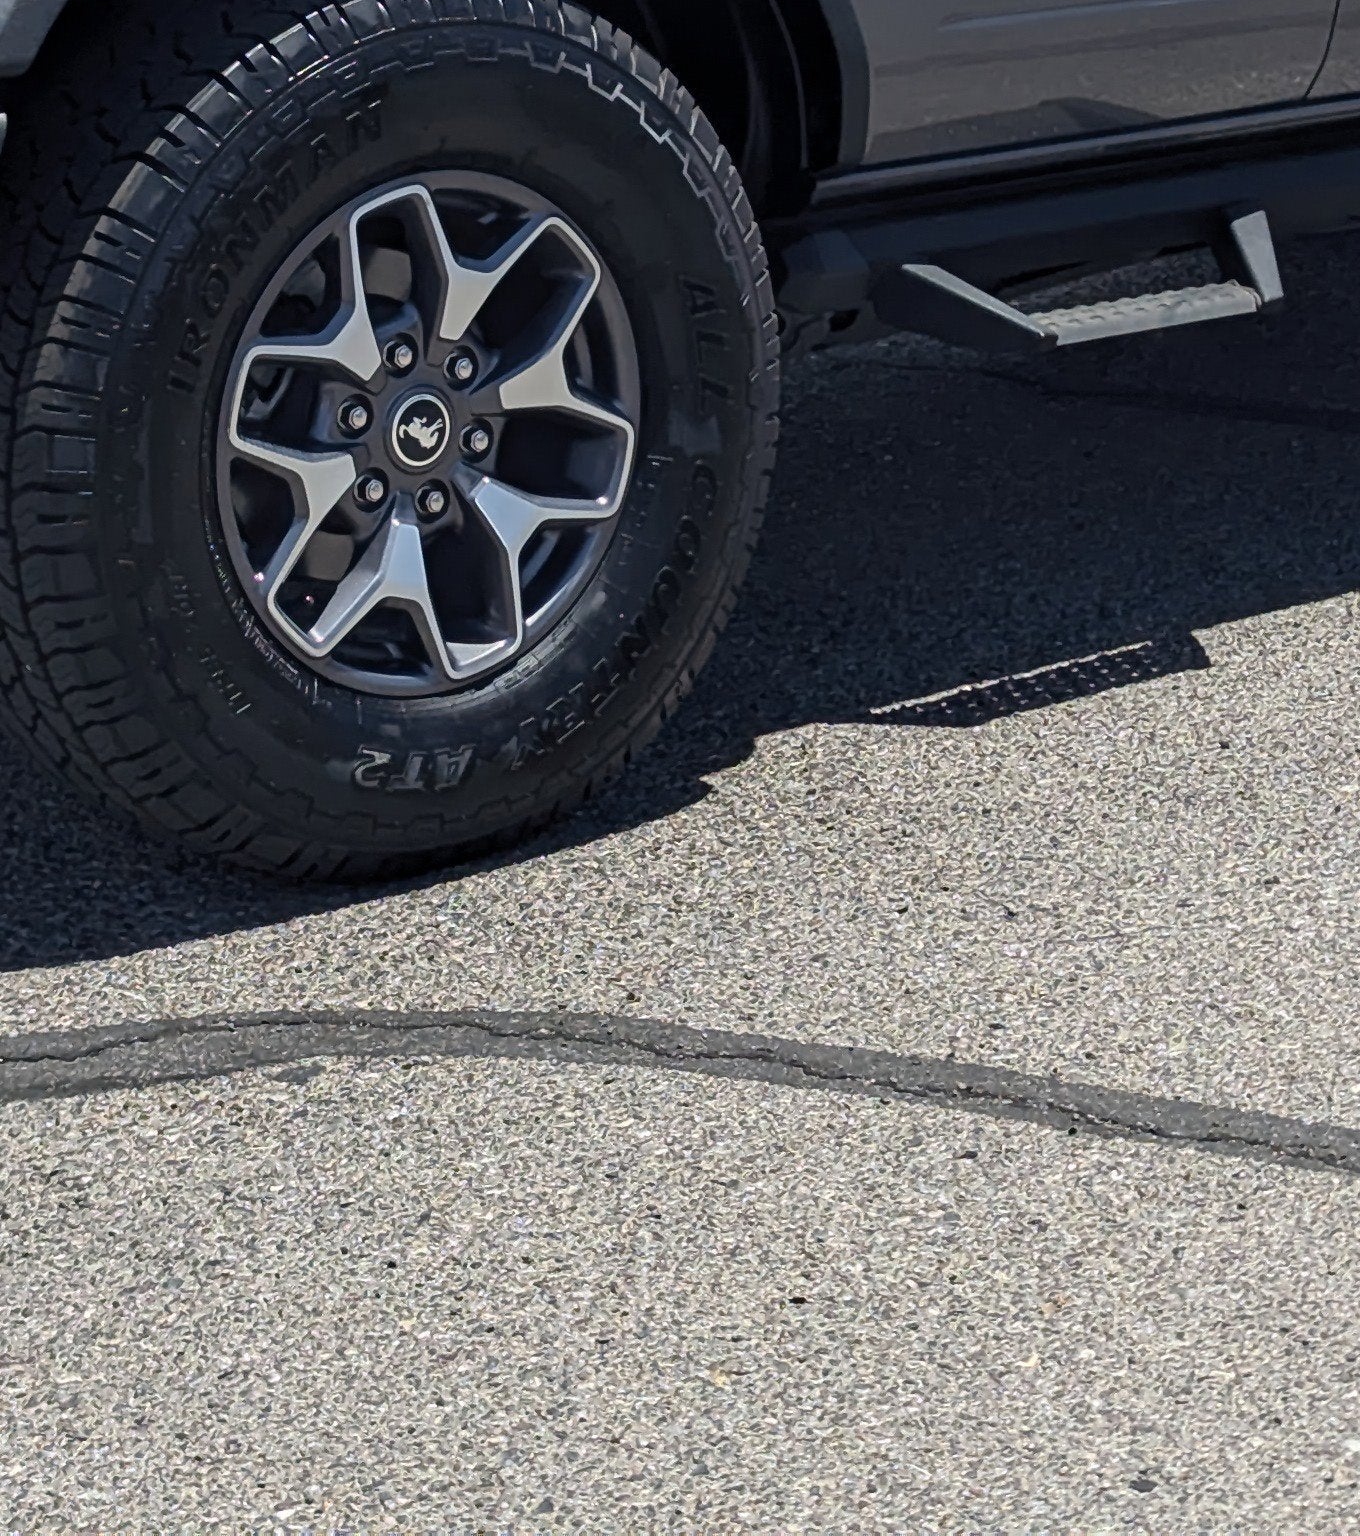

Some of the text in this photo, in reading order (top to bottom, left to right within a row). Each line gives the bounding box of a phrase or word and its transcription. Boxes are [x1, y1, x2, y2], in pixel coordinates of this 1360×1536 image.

[166, 99, 382, 394] IRONMAN
[679, 274, 734, 420] ALL
[353, 743, 475, 791] AT2
